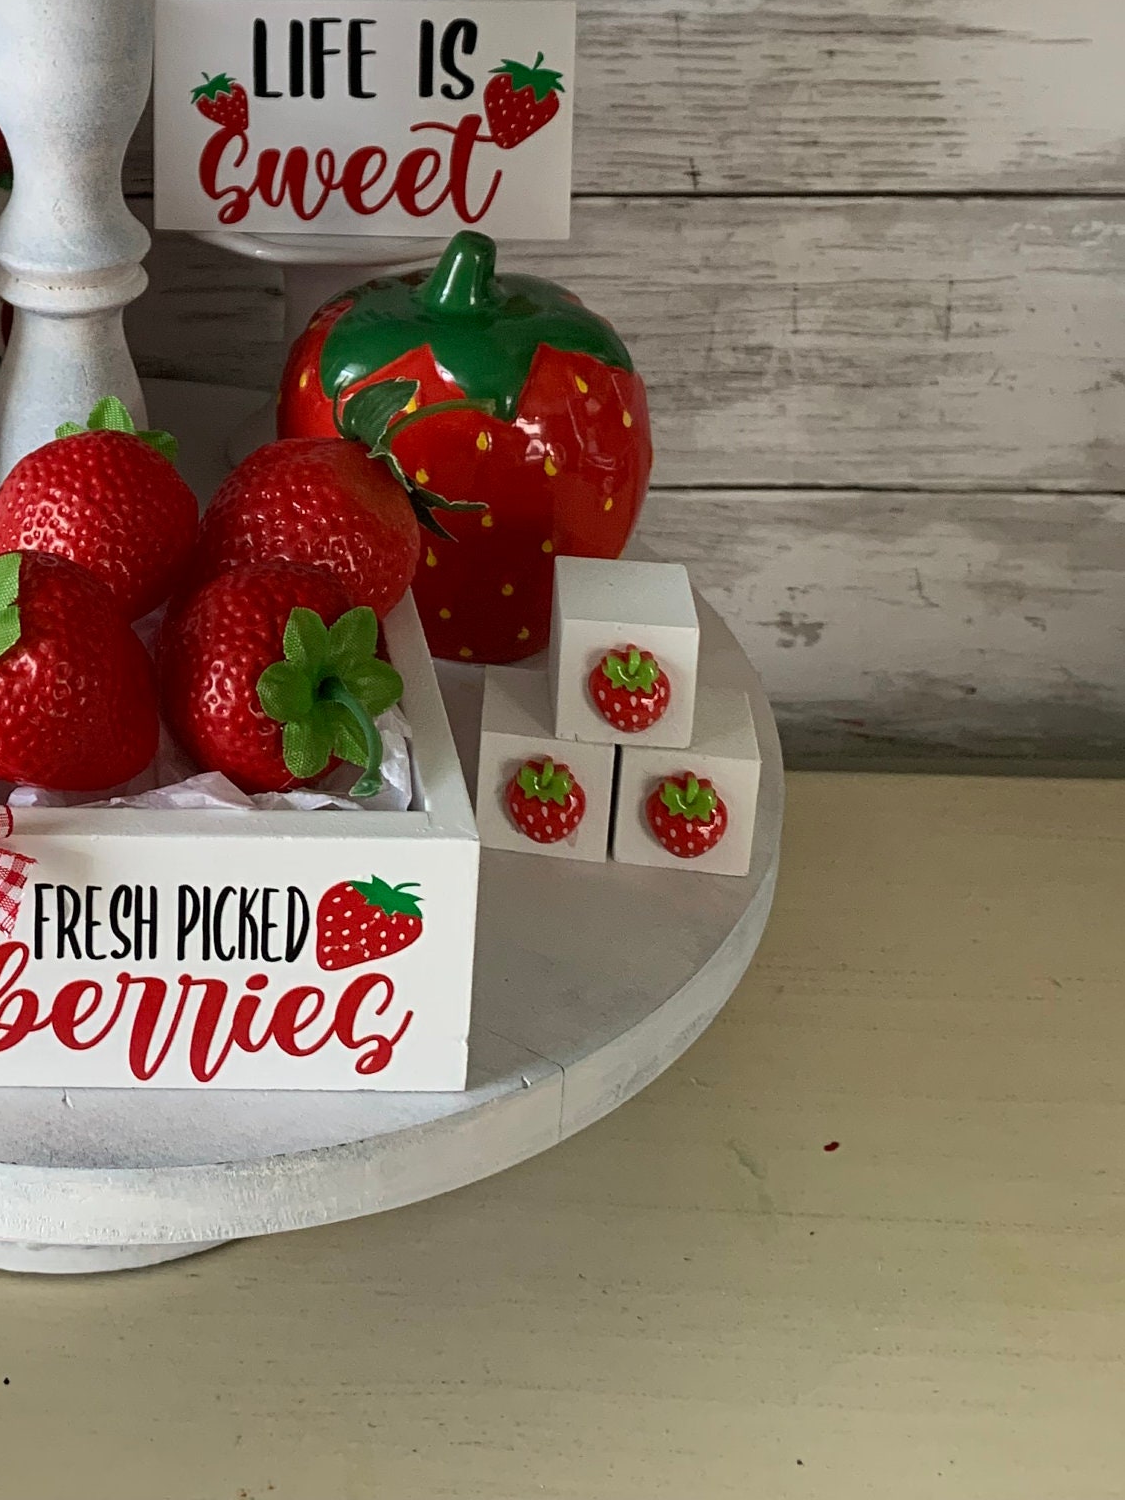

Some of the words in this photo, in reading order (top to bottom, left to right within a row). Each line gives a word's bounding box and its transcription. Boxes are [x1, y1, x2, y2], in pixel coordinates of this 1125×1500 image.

[252, 17, 378, 100] LIFE
[418, 17, 478, 100] IS
[32, 882, 158, 961] FRESH
[176, 883, 311, 963] PICKED
